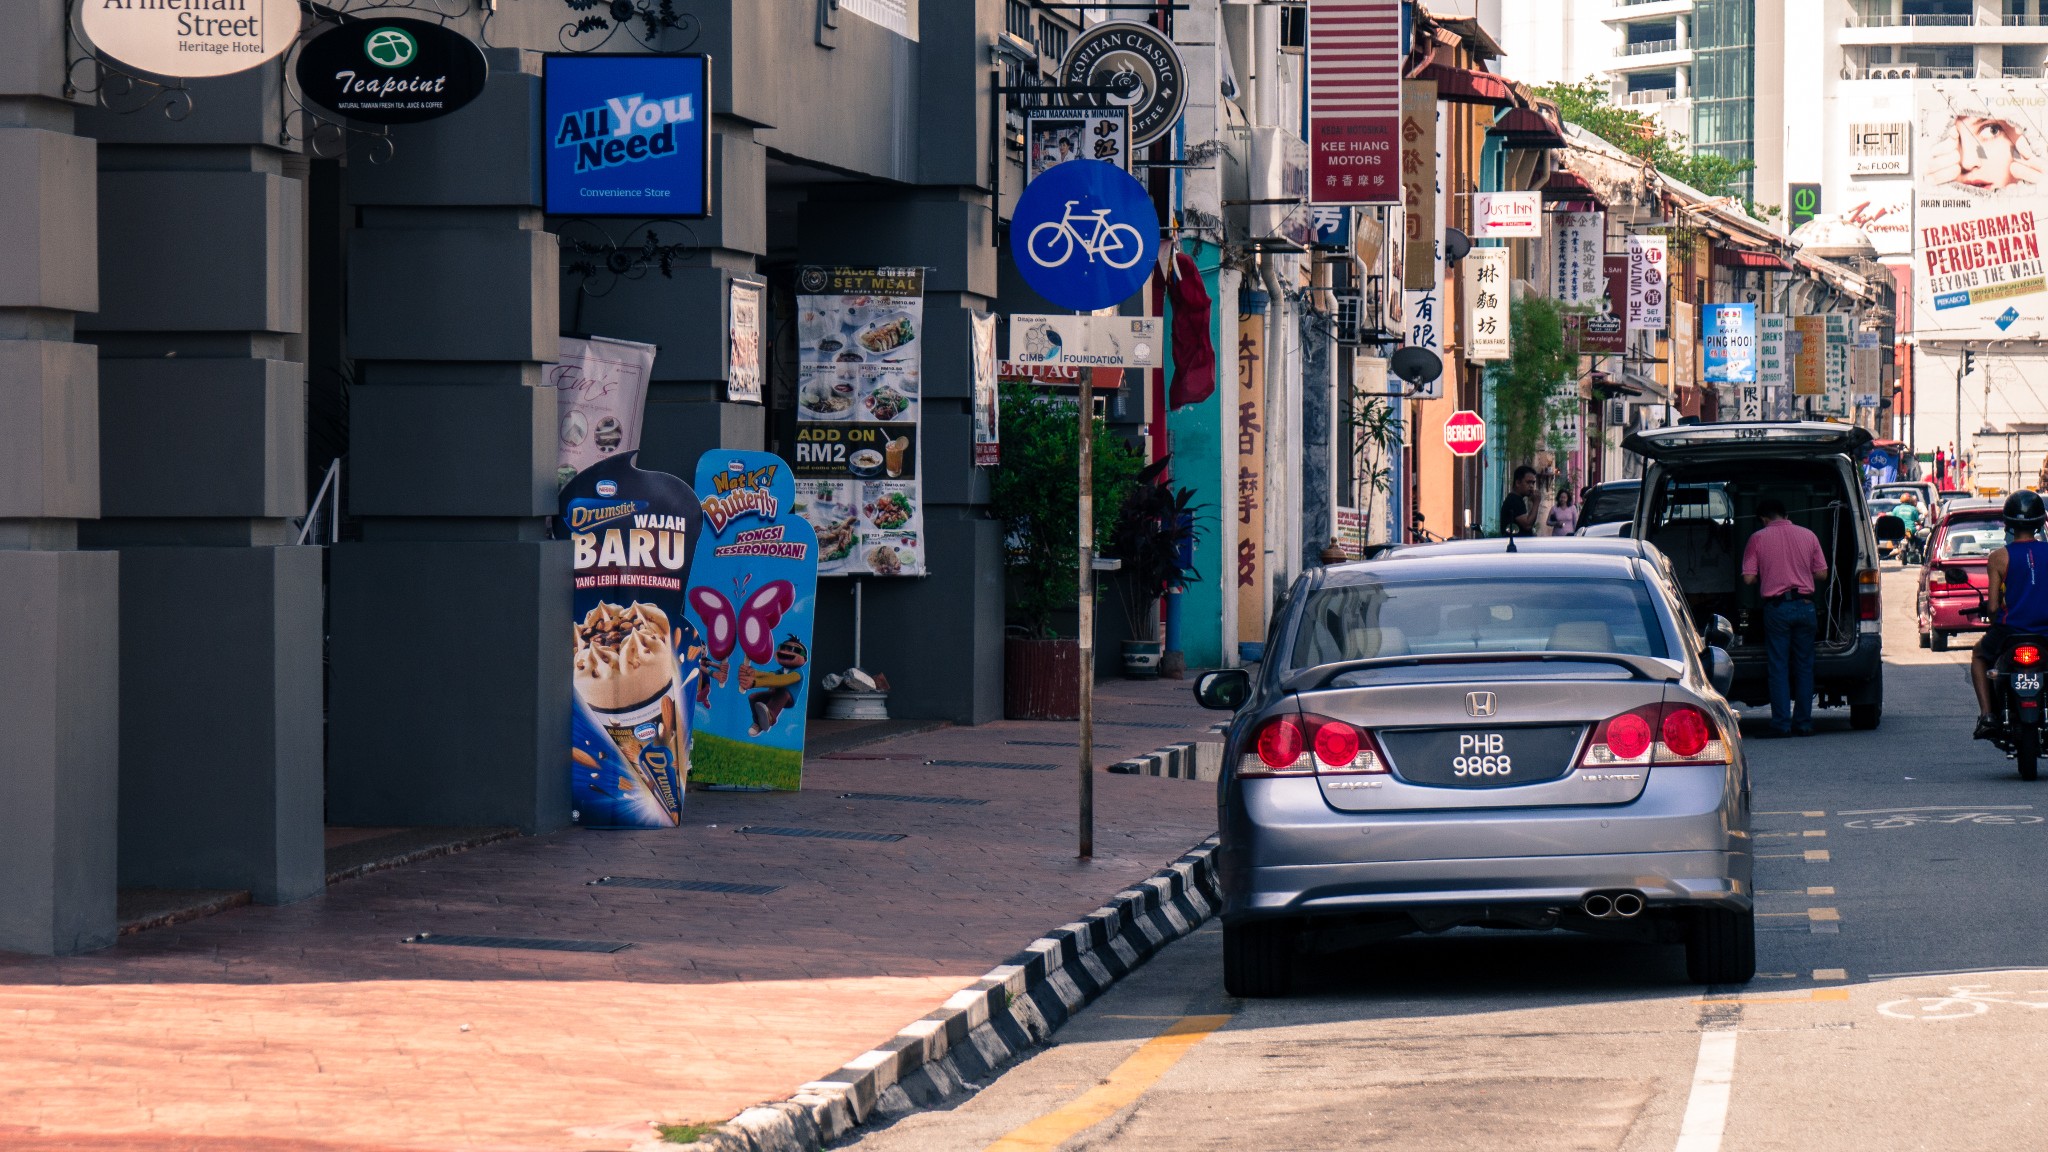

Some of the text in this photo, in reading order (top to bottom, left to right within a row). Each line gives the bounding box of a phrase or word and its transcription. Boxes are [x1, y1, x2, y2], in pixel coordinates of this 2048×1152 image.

[178, 12, 259, 37] Street
[179, 41, 229, 54] Heritage
[1072, 34, 1173, 83] KOPITAN CLASSIC
[335, 71, 446, 97] Teapoint
[557, 96, 692, 144] All You
[1027, 110, 1124, 118] KEDAI MAKANAN & MINUMAN
[1132, 105, 1165, 133] OFFEE
[576, 123, 675, 170] Need
[1321, 141, 1390, 151] KEE HIANG
[1856, 133, 1899, 145] ICT
[1328, 155, 1381, 166] MOTORS
[1871, 162, 1900, 170] FLOOR
[580, 187, 671, 197] Convenience Store
[1921, 199, 1940, 208] AKAN
[1921, 210, 2036, 249] TRANSFORMASI
[1926, 233, 2040, 277] PERUBAHAN
[834, 278, 916, 290] SET MEAL
[1630, 247, 1643, 323] THE VINTAGE
[1930, 271, 1979, 294] BEYOND
[1983, 266, 2005, 284] THE
[2010, 260, 2044, 280] WALL
[1768, 319, 1783, 328] BUKU
[1707, 336, 1752, 348] PING HOOI
[1761, 333, 1783, 342] DREN'S
[1019, 353, 1044, 362] CIMB
[1063, 354, 1124, 365] FOUNDATION
[1761, 346, 1777, 355] ORLD
[797, 429, 875, 442] ADD ON
[1446, 424, 1483, 442] BERHENTI
[796, 443, 846, 462] RM2
[713, 471, 745, 495] Mat
[572, 501, 636, 528] Drumstick
[702, 490, 778, 533] Butterfly
[634, 514, 685, 532] WAJAH
[736, 526, 784, 543] KONGSI
[573, 529, 685, 570] BARU
[714, 543, 806, 559] KESERONOKAN!
[575, 574, 681, 590] YANG LEBIH MENYELERAKAN!
[2015, 680, 2040, 690] 3279
[2017, 673, 2038, 682] PLJ
[1460, 734, 1504, 754] PHB
[1452, 756, 1512, 776] 9868
[646, 750, 677, 810] Drumstick
